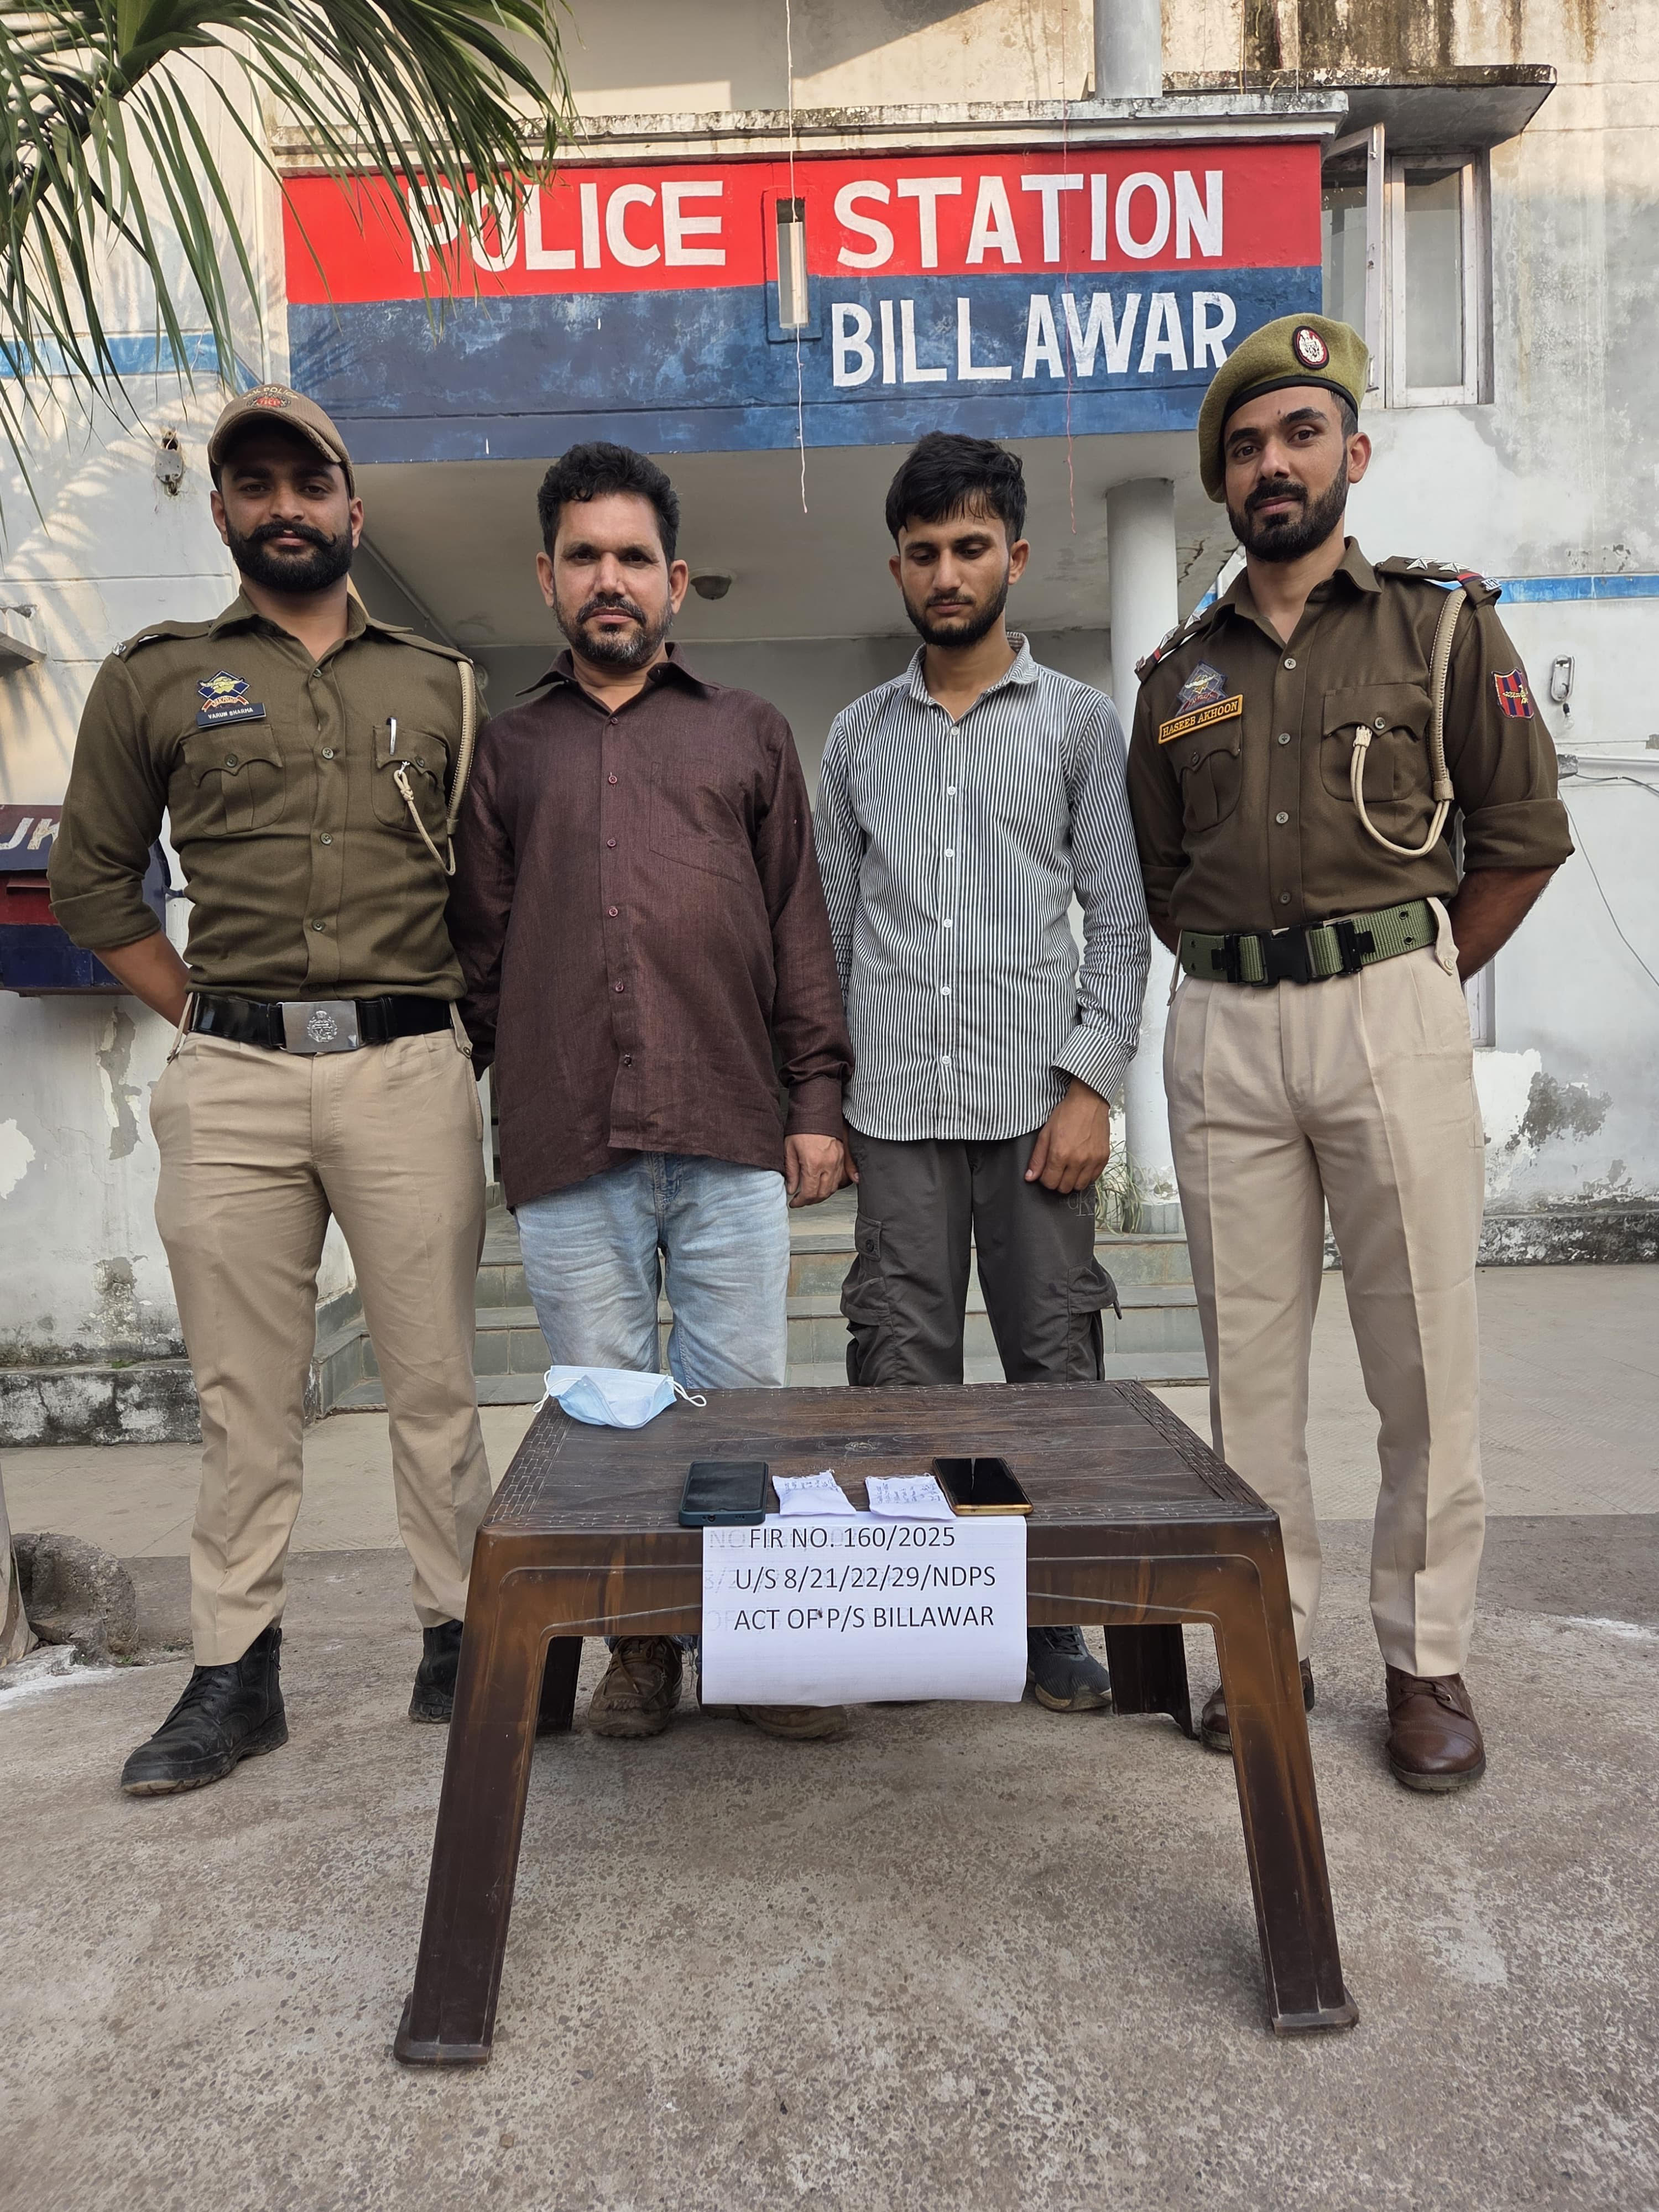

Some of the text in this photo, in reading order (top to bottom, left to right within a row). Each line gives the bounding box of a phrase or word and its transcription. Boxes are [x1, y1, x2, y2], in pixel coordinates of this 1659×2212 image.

[408, 170, 1223, 272] POLICE STATION
[831, 291, 1237, 388] BILLAWAR
[229, 707, 253, 716] SHARMA
[1162, 701, 1239, 738] HASEEB AKHOON
[750, 1528, 783, 1548] FIR
[792, 1528, 834, 1548] NO.
[844, 1525, 956, 1551] 160/2025
[735, 1566, 776, 1593] U/S
[784, 1564, 995, 1593] 8/21/22/29/NDPS
[734, 1609, 780, 1630] ACT
[787, 1608, 818, 1629] OF
[828, 1605, 865, 1632] P/S
[874, 1606, 994, 1627] BILLAWAR
